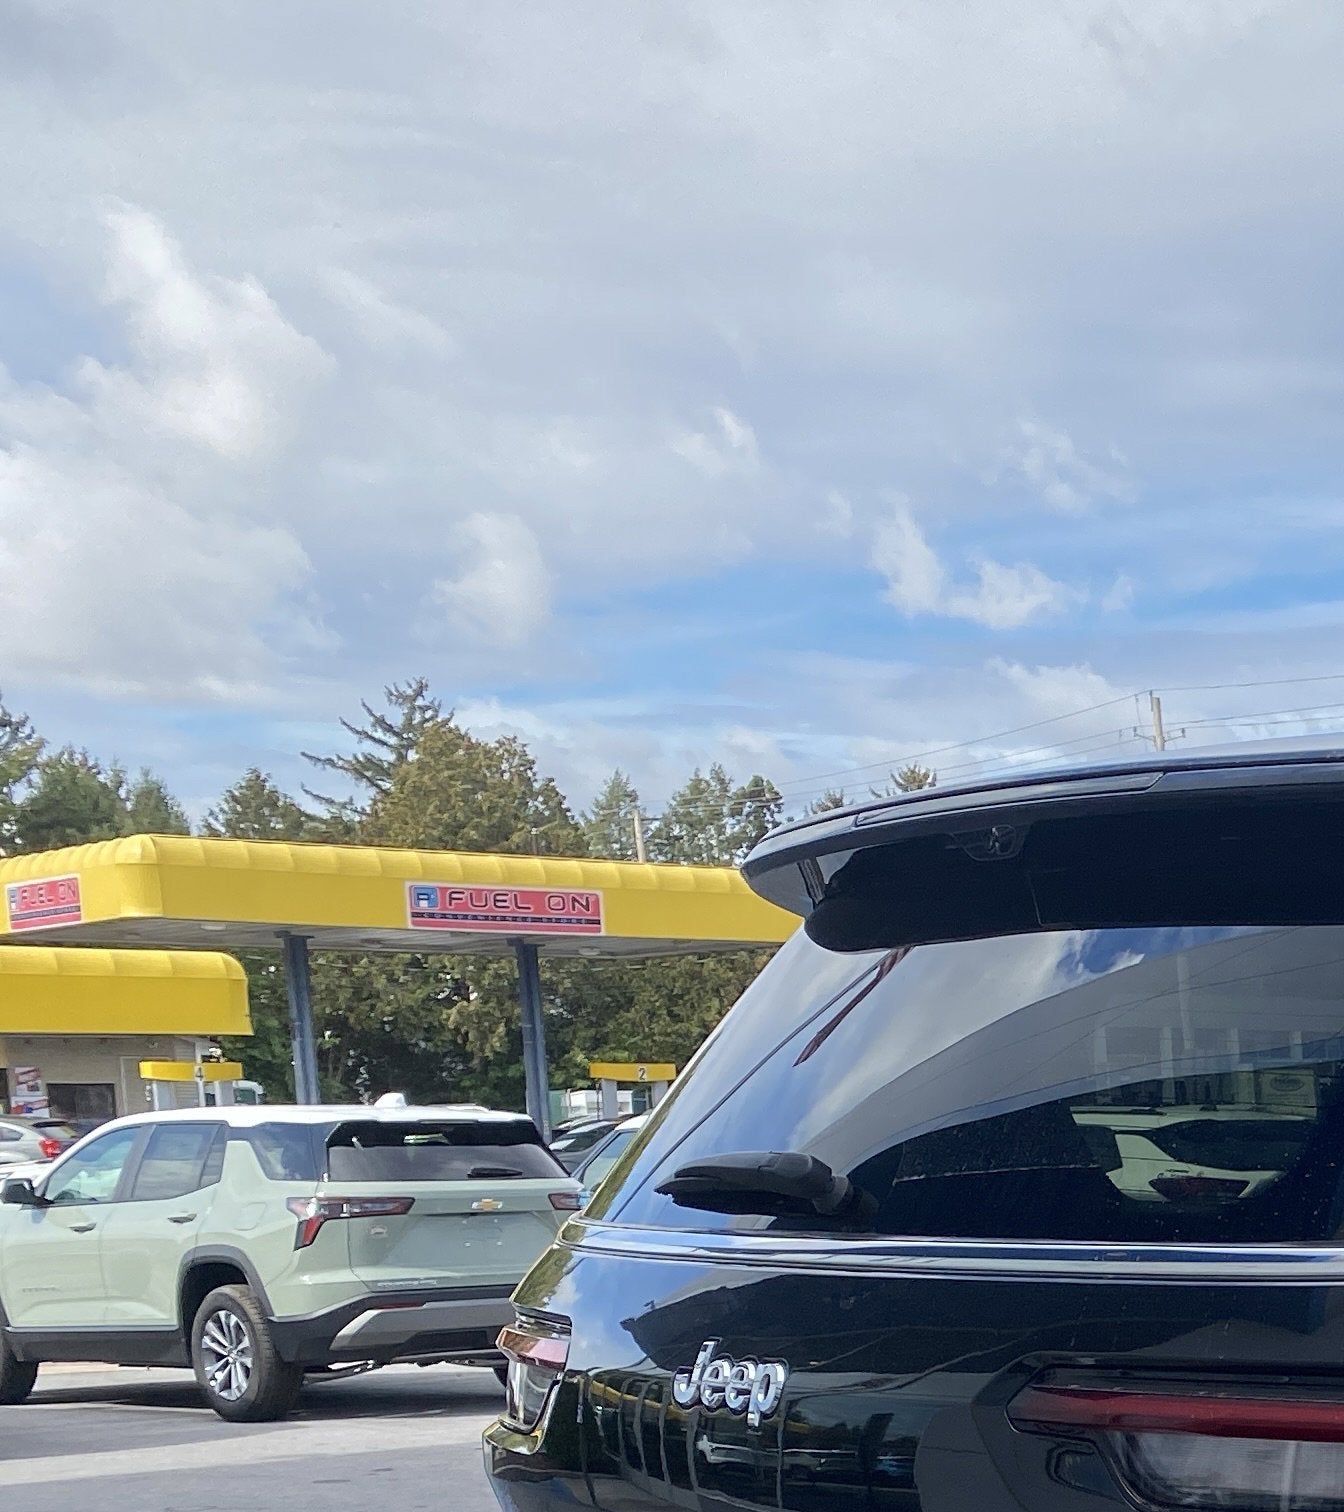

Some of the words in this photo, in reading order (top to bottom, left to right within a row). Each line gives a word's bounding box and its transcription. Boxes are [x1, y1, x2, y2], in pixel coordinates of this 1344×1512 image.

[20, 884, 55, 908] FUEL
[447, 889, 532, 911] FUEL
[547, 893, 592, 913] ON
[195, 1066, 204, 1081] 4
[638, 1067, 646, 1080] 2
[673, 1340, 786, 1427] Jeep
